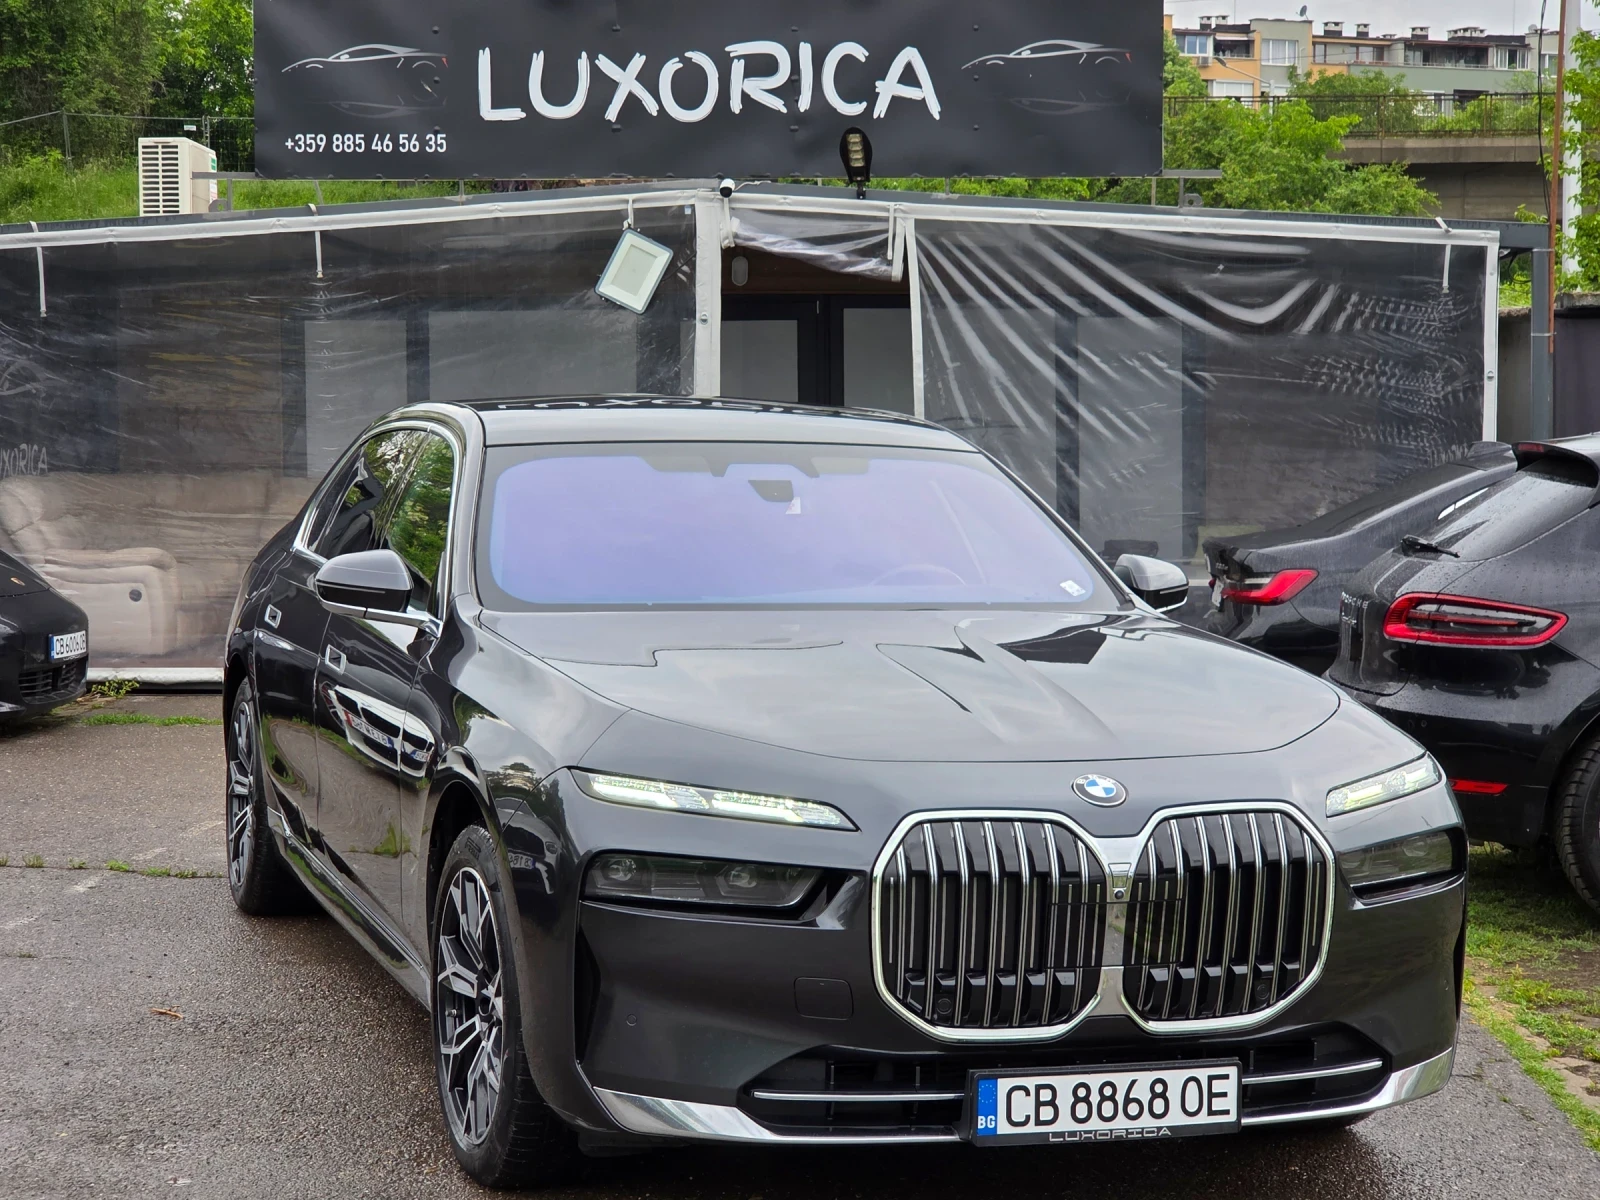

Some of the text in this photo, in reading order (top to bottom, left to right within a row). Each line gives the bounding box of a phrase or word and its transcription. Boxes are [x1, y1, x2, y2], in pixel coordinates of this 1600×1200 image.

[478, 40, 941, 123] LUXORICA
[285, 133, 447, 153] +359 885 46 56 35
[977, 1115, 996, 1130] BG
[1006, 1083, 1060, 1128] CB
[1070, 1077, 1170, 1125] 8868
[1049, 1126, 1172, 1142] LUXORICA
